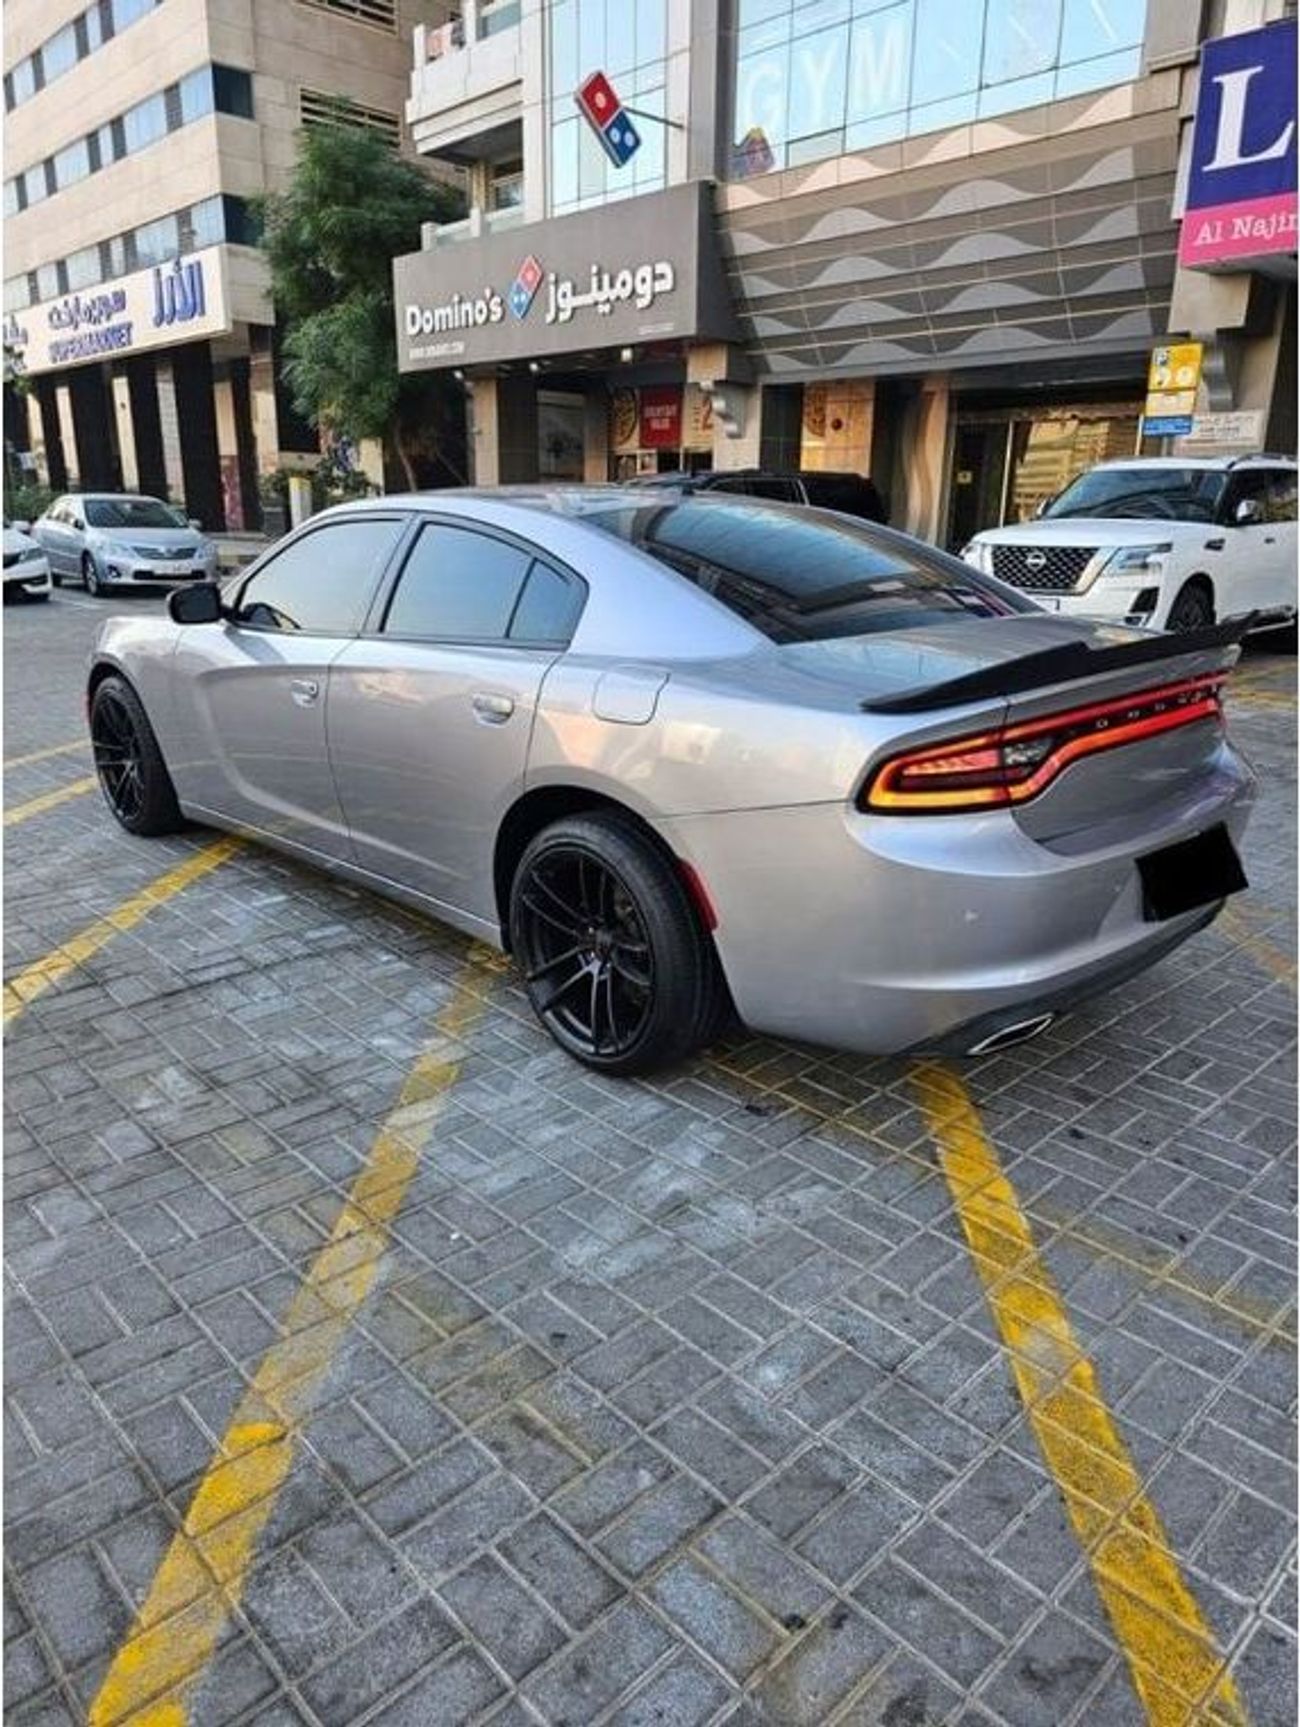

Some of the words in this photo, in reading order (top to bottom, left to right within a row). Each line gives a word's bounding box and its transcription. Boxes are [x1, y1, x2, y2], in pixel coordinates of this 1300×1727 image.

[745, 24, 906, 128] GYM
[1202, 65, 1294, 171] L
[1193, 220, 1223, 246] Al
[405, 286, 505, 336] Domino's
[546, 260, 675, 323] دومينوز
